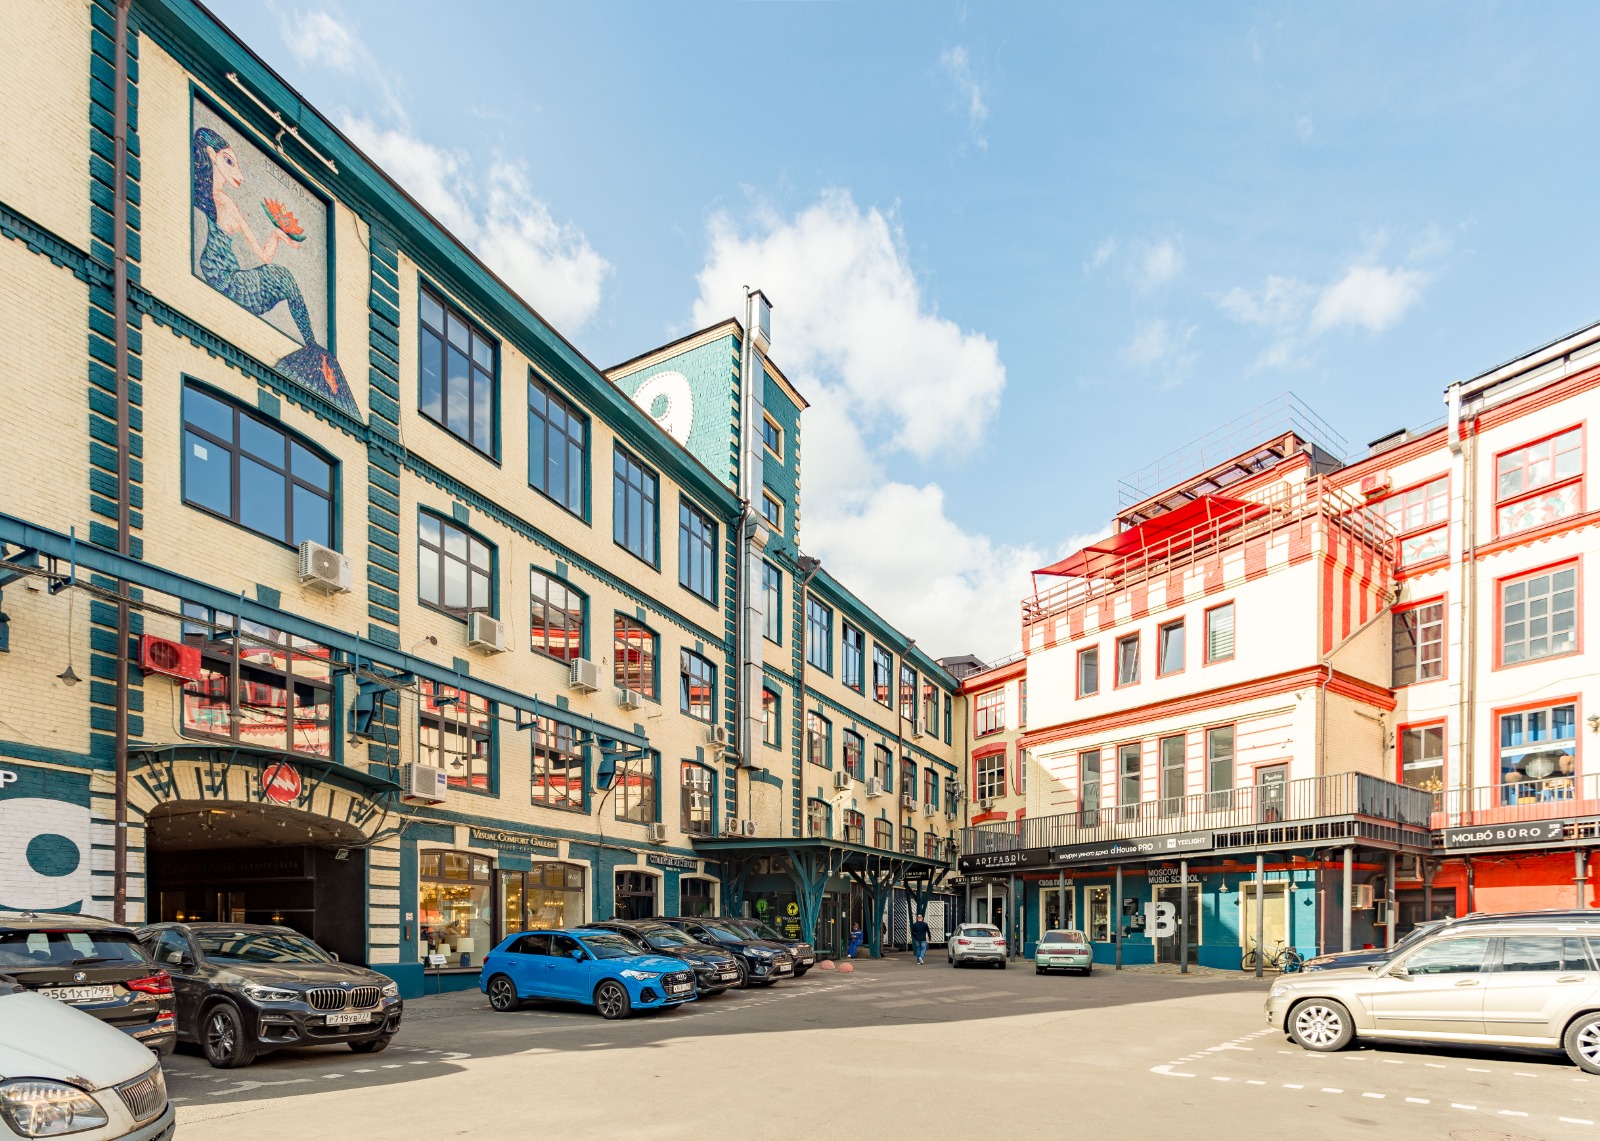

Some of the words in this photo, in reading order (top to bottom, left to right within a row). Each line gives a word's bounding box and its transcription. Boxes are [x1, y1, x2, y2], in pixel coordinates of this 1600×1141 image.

[1452, 830, 1493, 842] MOLBÓ
[1138, 843, 1154, 852] PRO
[1177, 837, 1206, 846] YEELIGHT
[976, 853, 1027, 865] ARTFABRIC
[1148, 868, 1179, 876] MOSCOW
[1148, 876, 1169, 884] MUSIC
